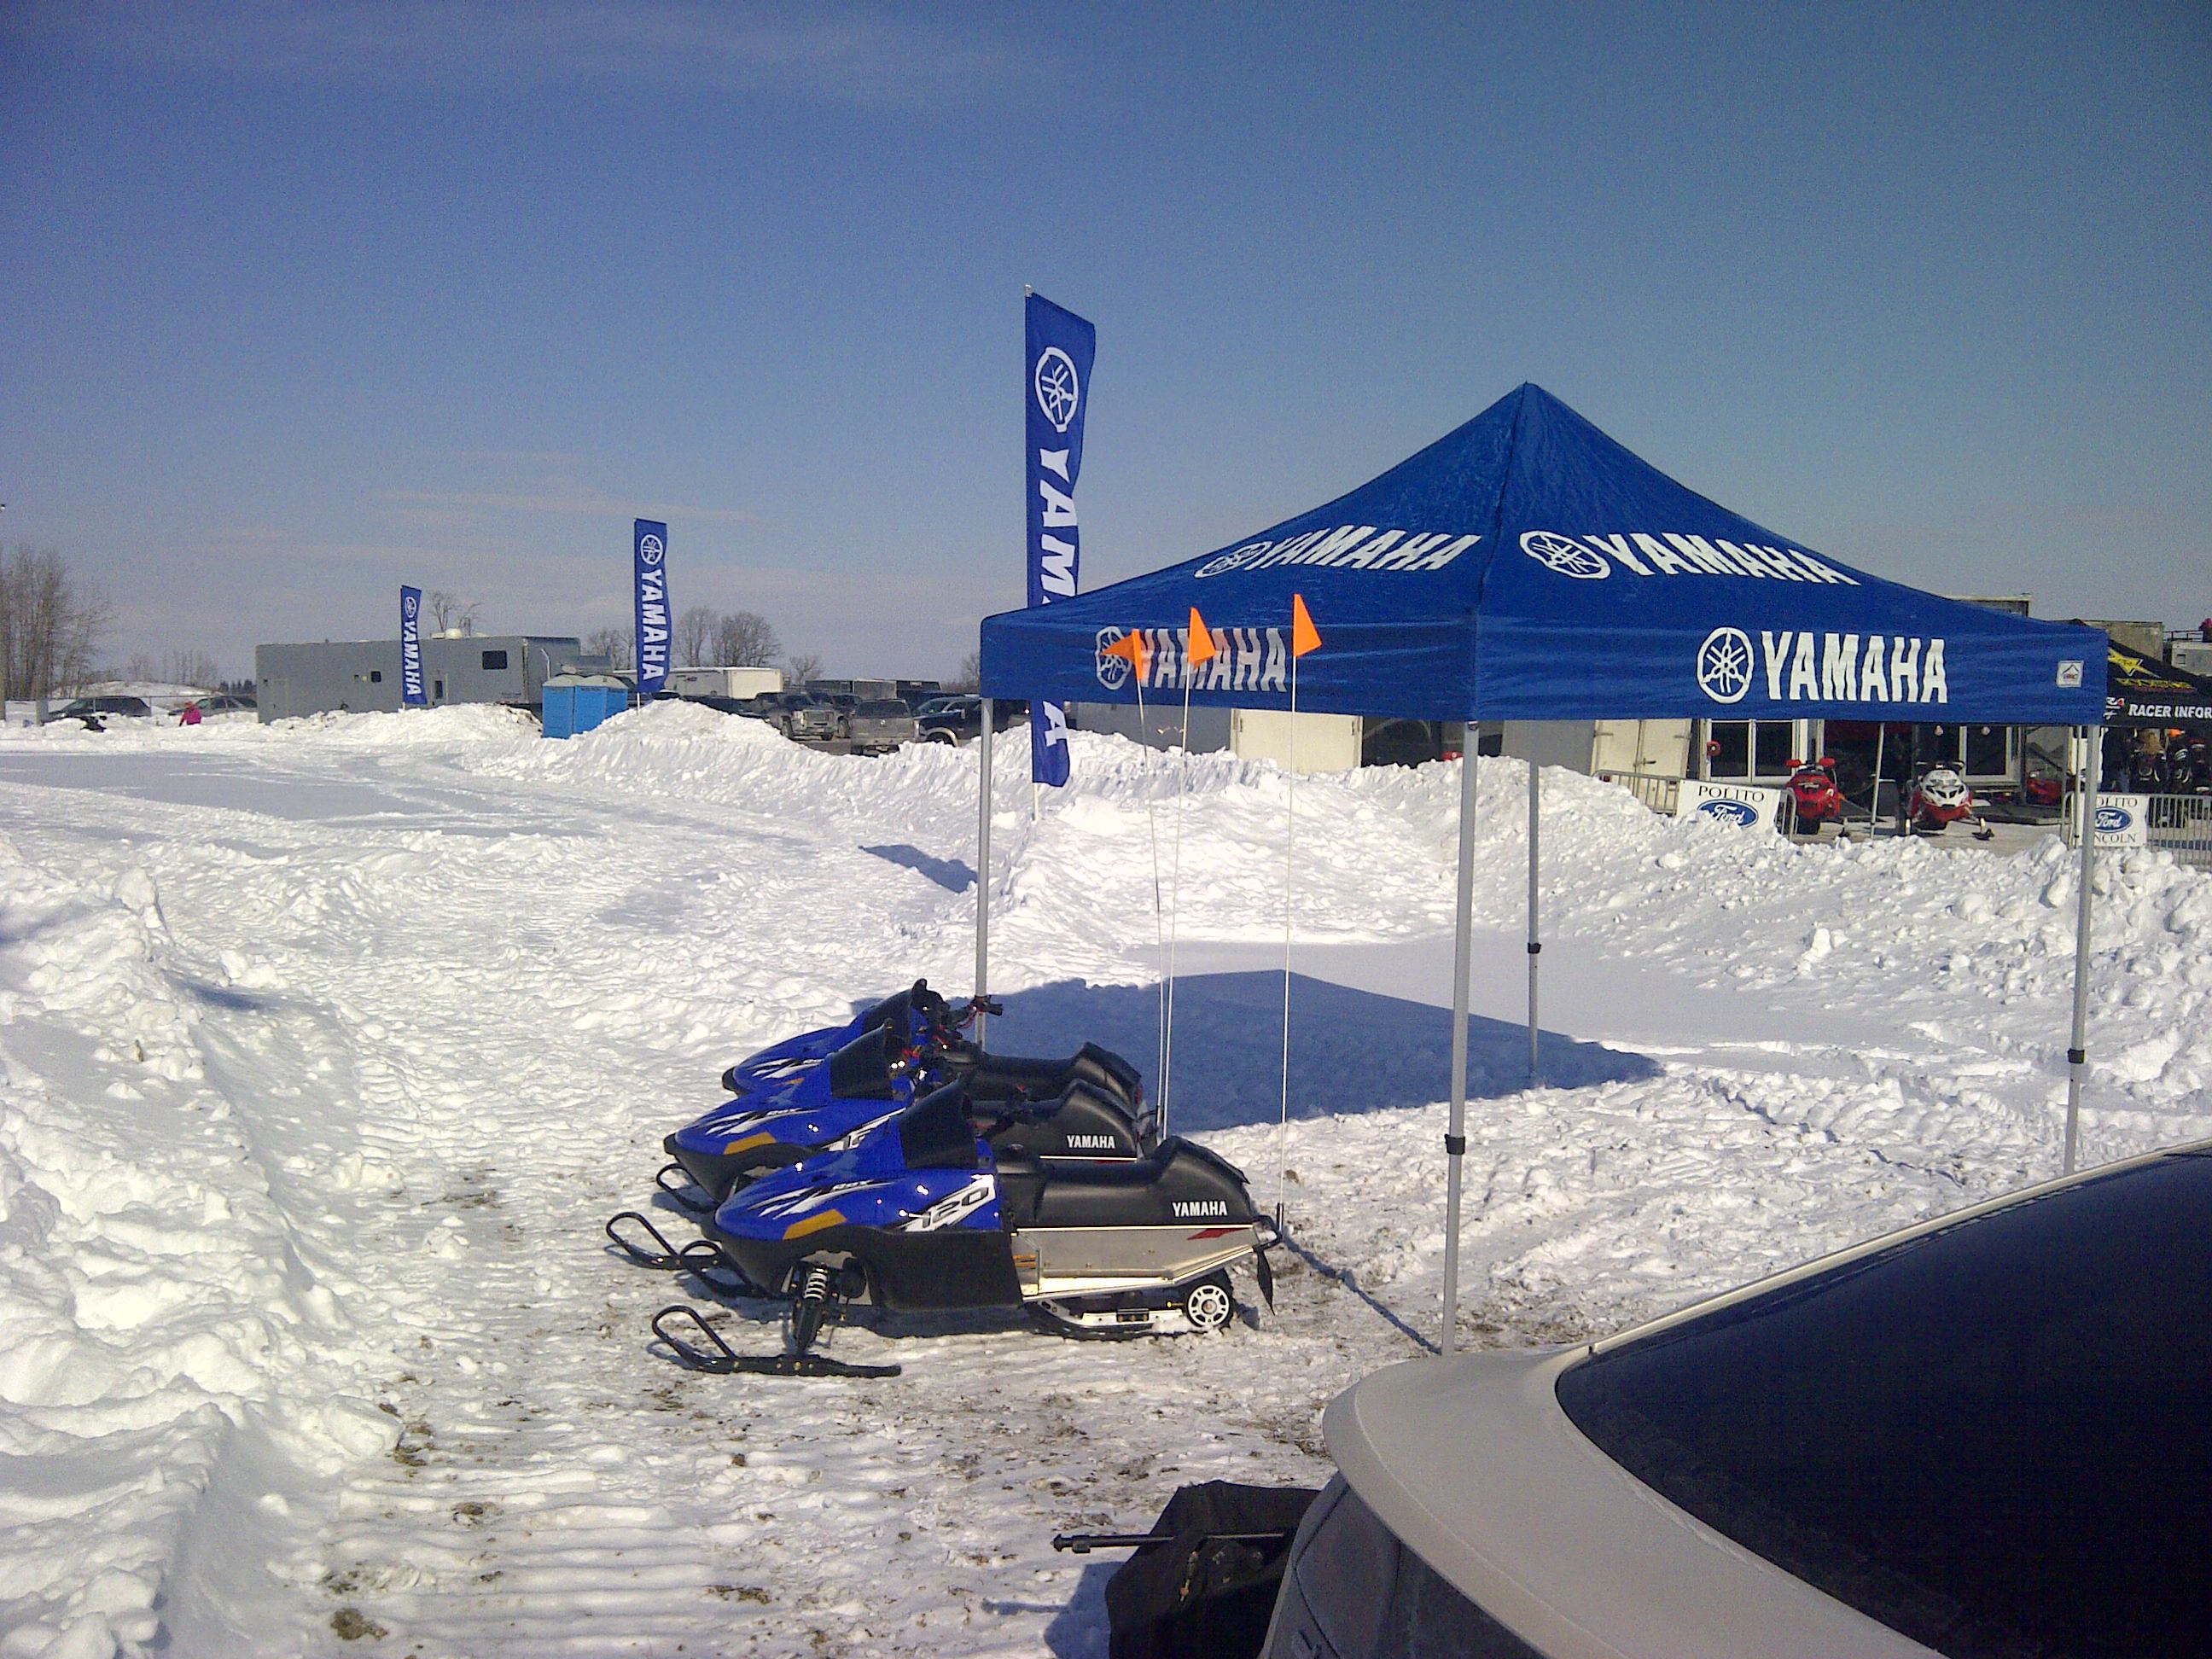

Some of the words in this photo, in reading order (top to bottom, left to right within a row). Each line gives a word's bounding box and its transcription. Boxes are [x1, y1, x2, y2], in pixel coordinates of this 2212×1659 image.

[1244, 525, 1482, 571] YAMAHA
[1583, 533, 1862, 586] YAMAHA
[640, 568, 668, 680] YAMAHA
[403, 620, 422, 696] YAMAHA
[1761, 630, 1949, 704] YAMAHA
[2128, 703, 2172, 718] RACER
[1698, 785, 1765, 802] POLITO
[2096, 796, 2138, 808] OLITO
[2095, 811, 2123, 828] Ford
[2093, 833, 2137, 843] NCOLN
[1066, 1135, 1115, 1149] YAMAHA
[1172, 1201, 1228, 1217] YAMAHA
